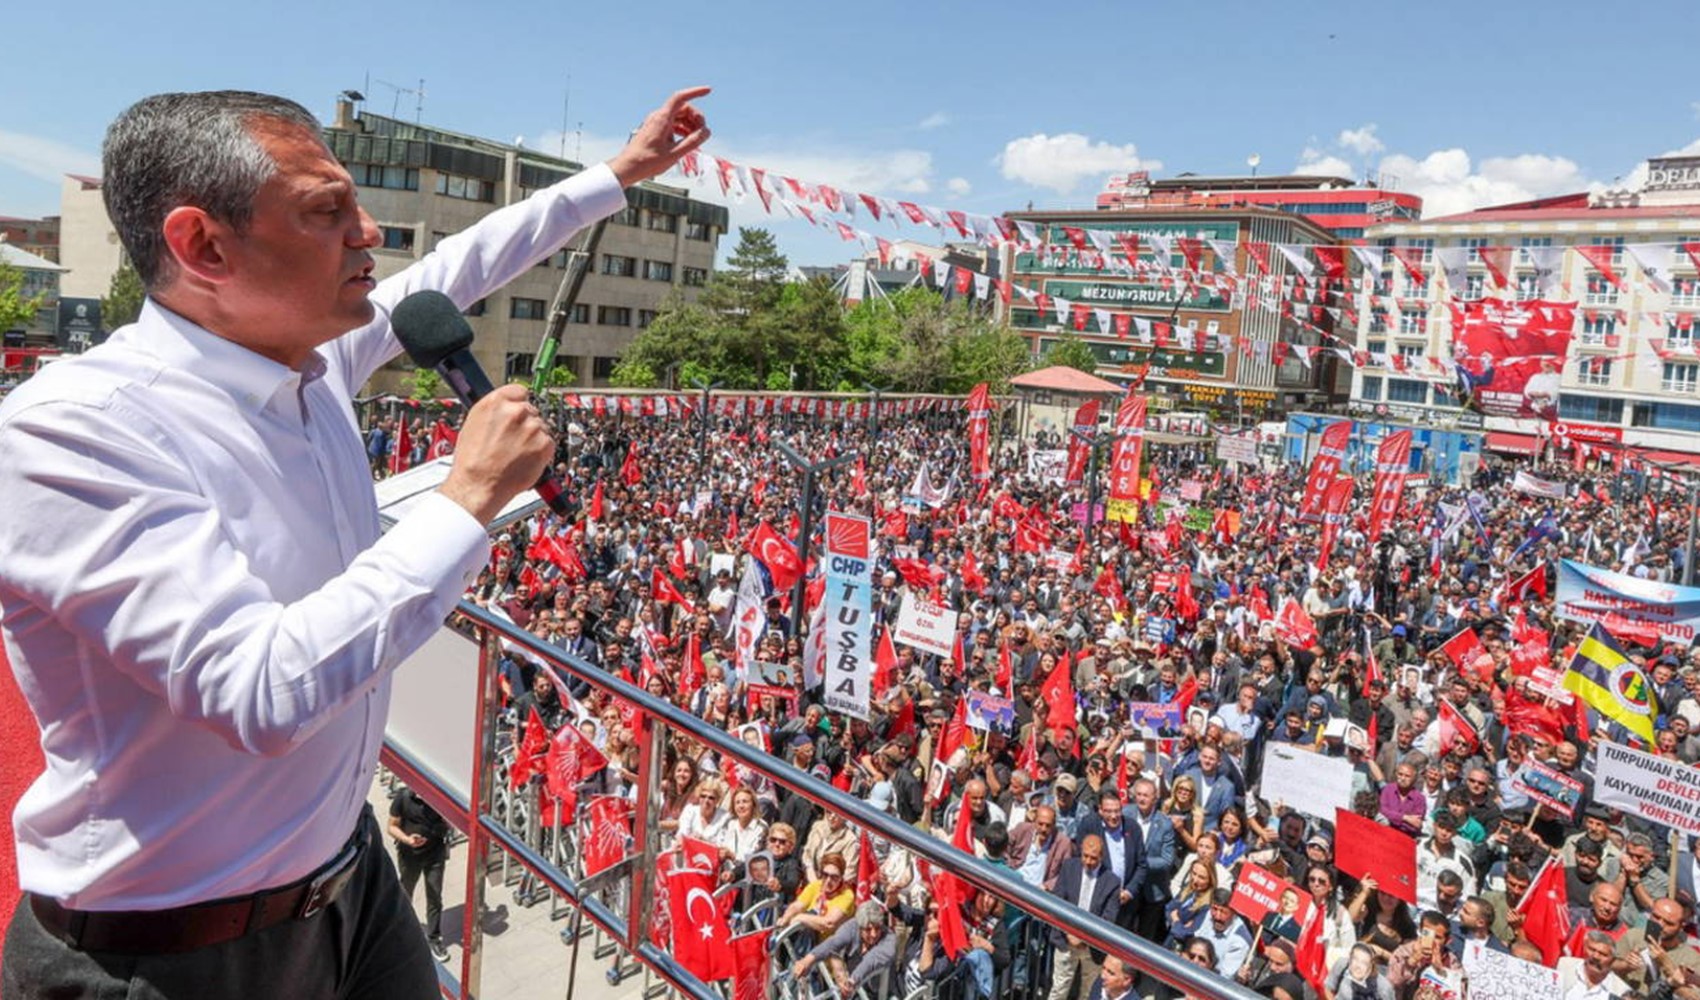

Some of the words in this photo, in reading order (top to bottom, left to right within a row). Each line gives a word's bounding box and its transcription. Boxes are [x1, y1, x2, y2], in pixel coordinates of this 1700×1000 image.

[1569, 427, 1617, 440] vodafone
[831, 556, 866, 577] CHP
[1584, 589, 1619, 607] HALK
[835, 583, 860, 697] TUŞBA
[1605, 746, 1673, 778] TURPUNAN
[1673, 767, 1700, 787] ŞAL
[1603, 775, 1693, 815] KAYYUMUNAN
